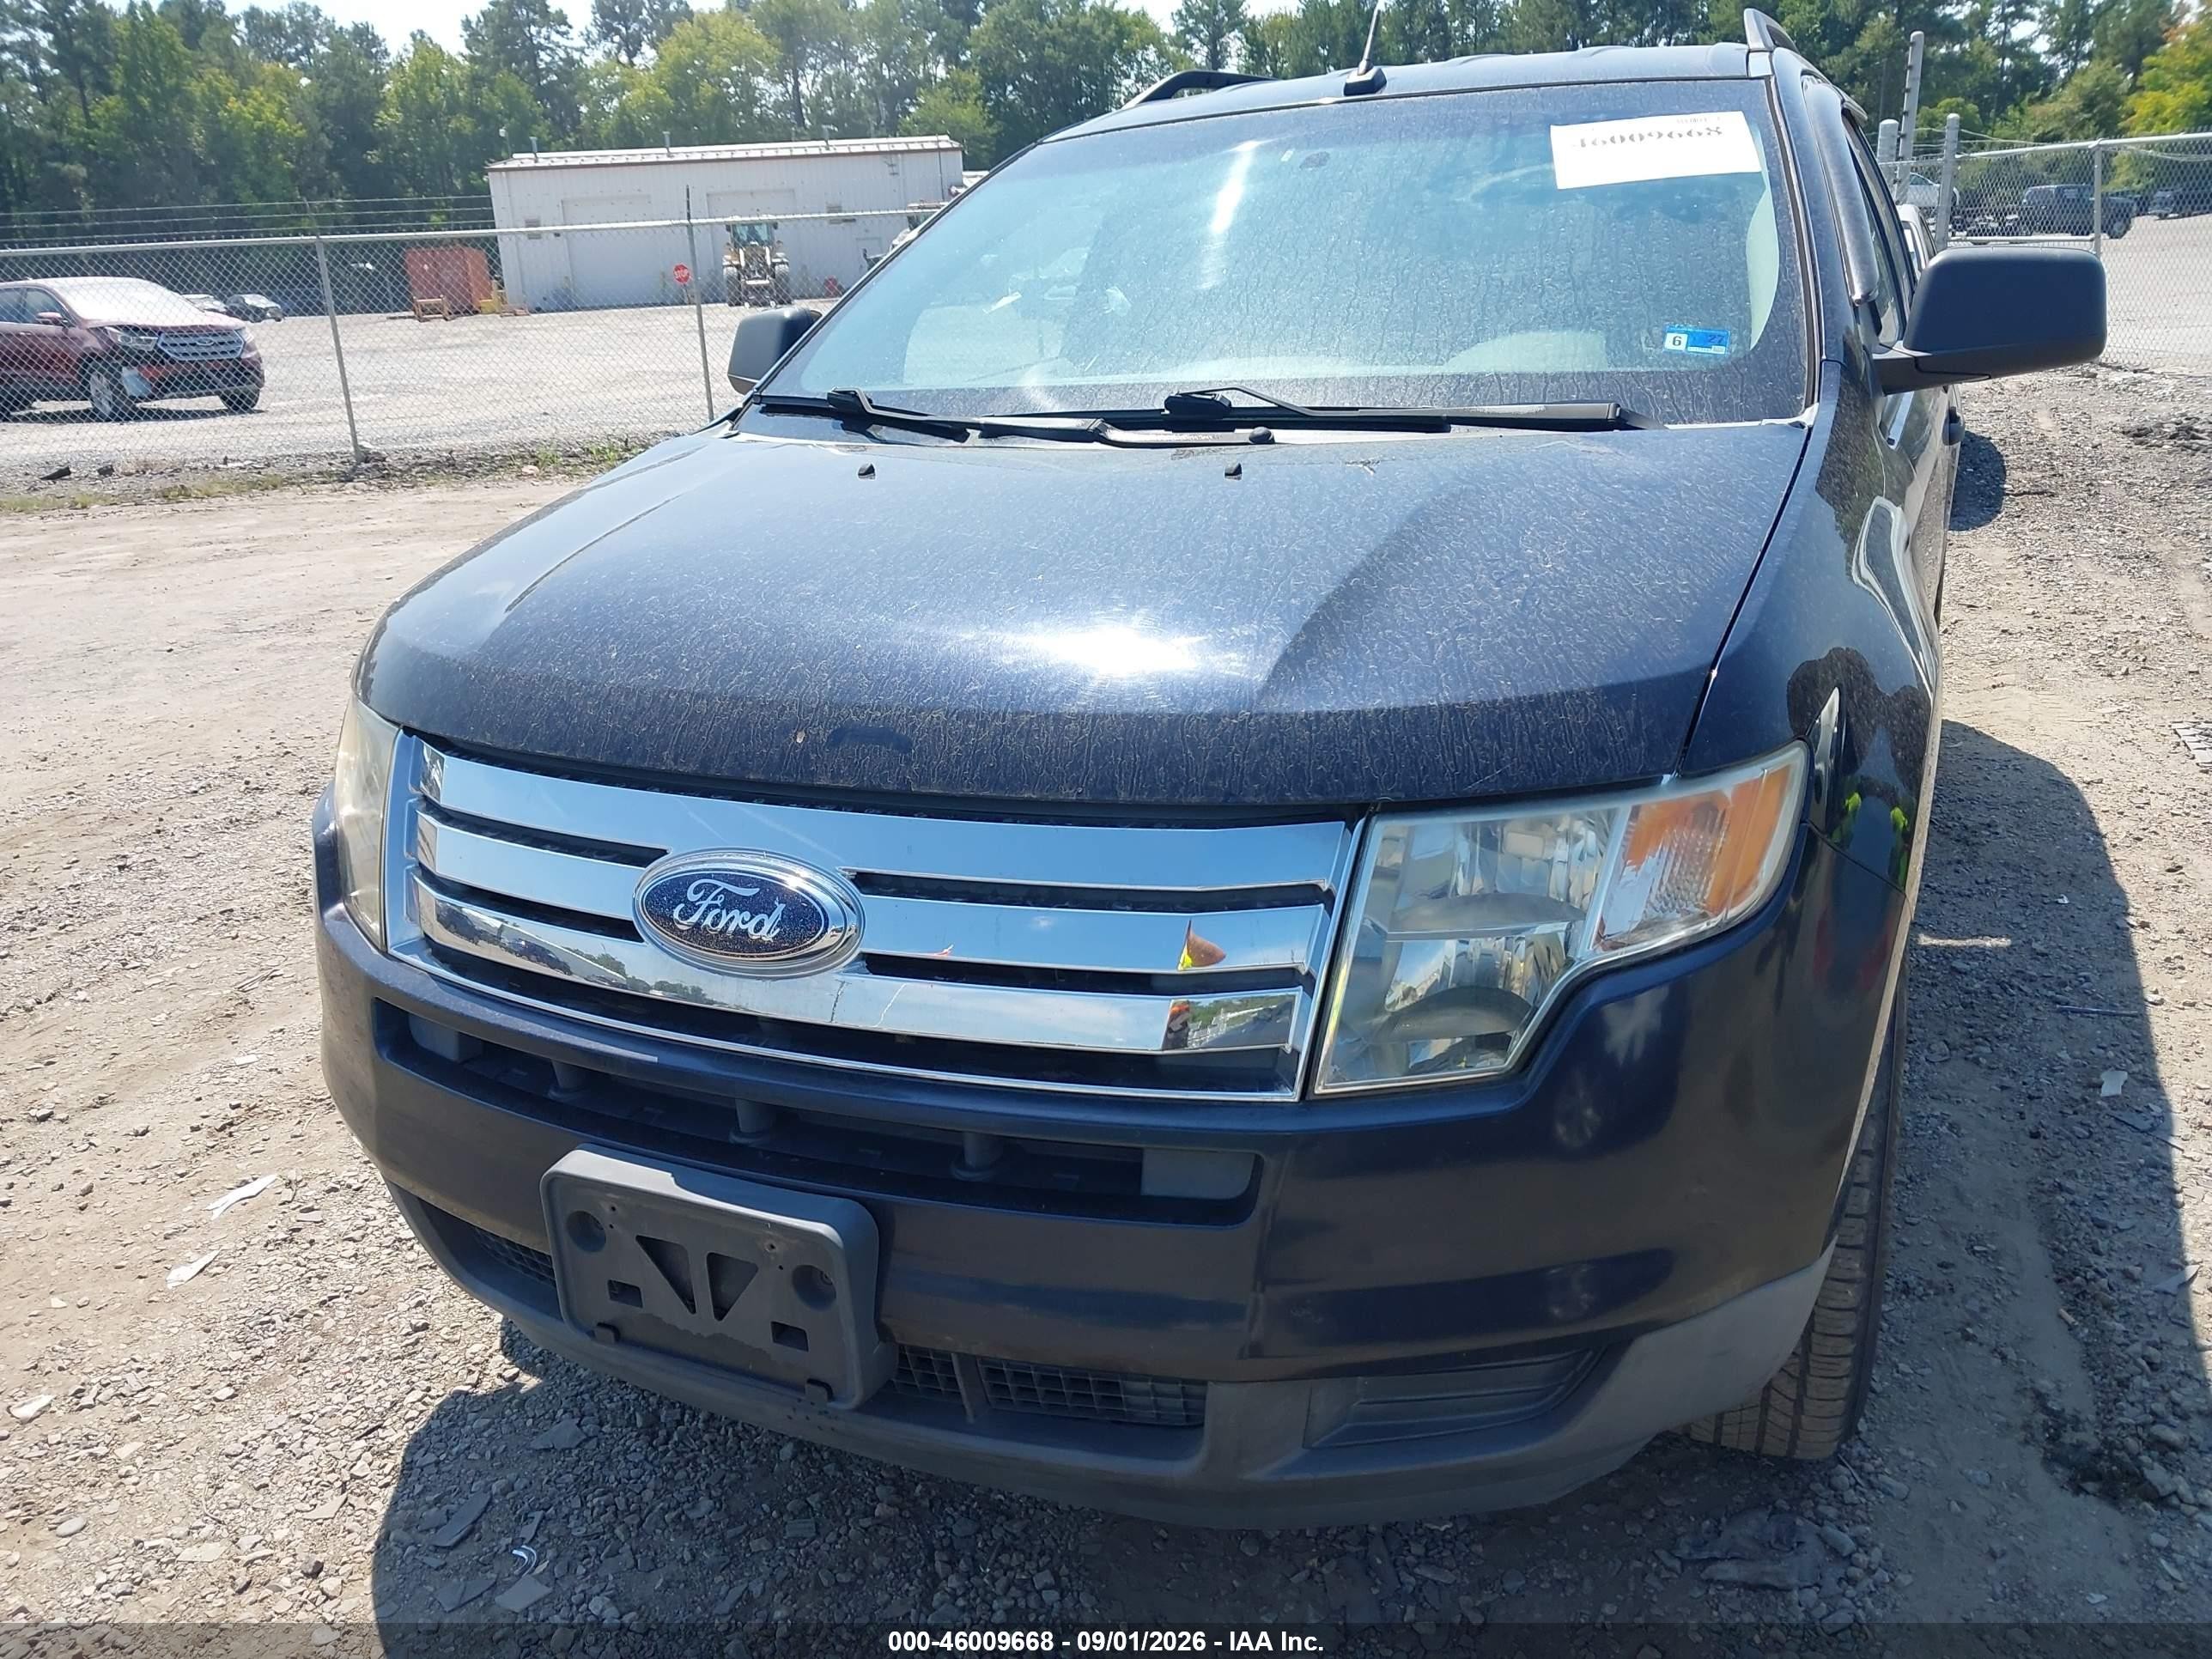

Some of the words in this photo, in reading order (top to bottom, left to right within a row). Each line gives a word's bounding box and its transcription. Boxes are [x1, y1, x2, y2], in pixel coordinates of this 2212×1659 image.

[1672, 336, 1682, 347] 6
[1708, 334, 1724, 344] 27
[673, 878, 786, 942] Ford
